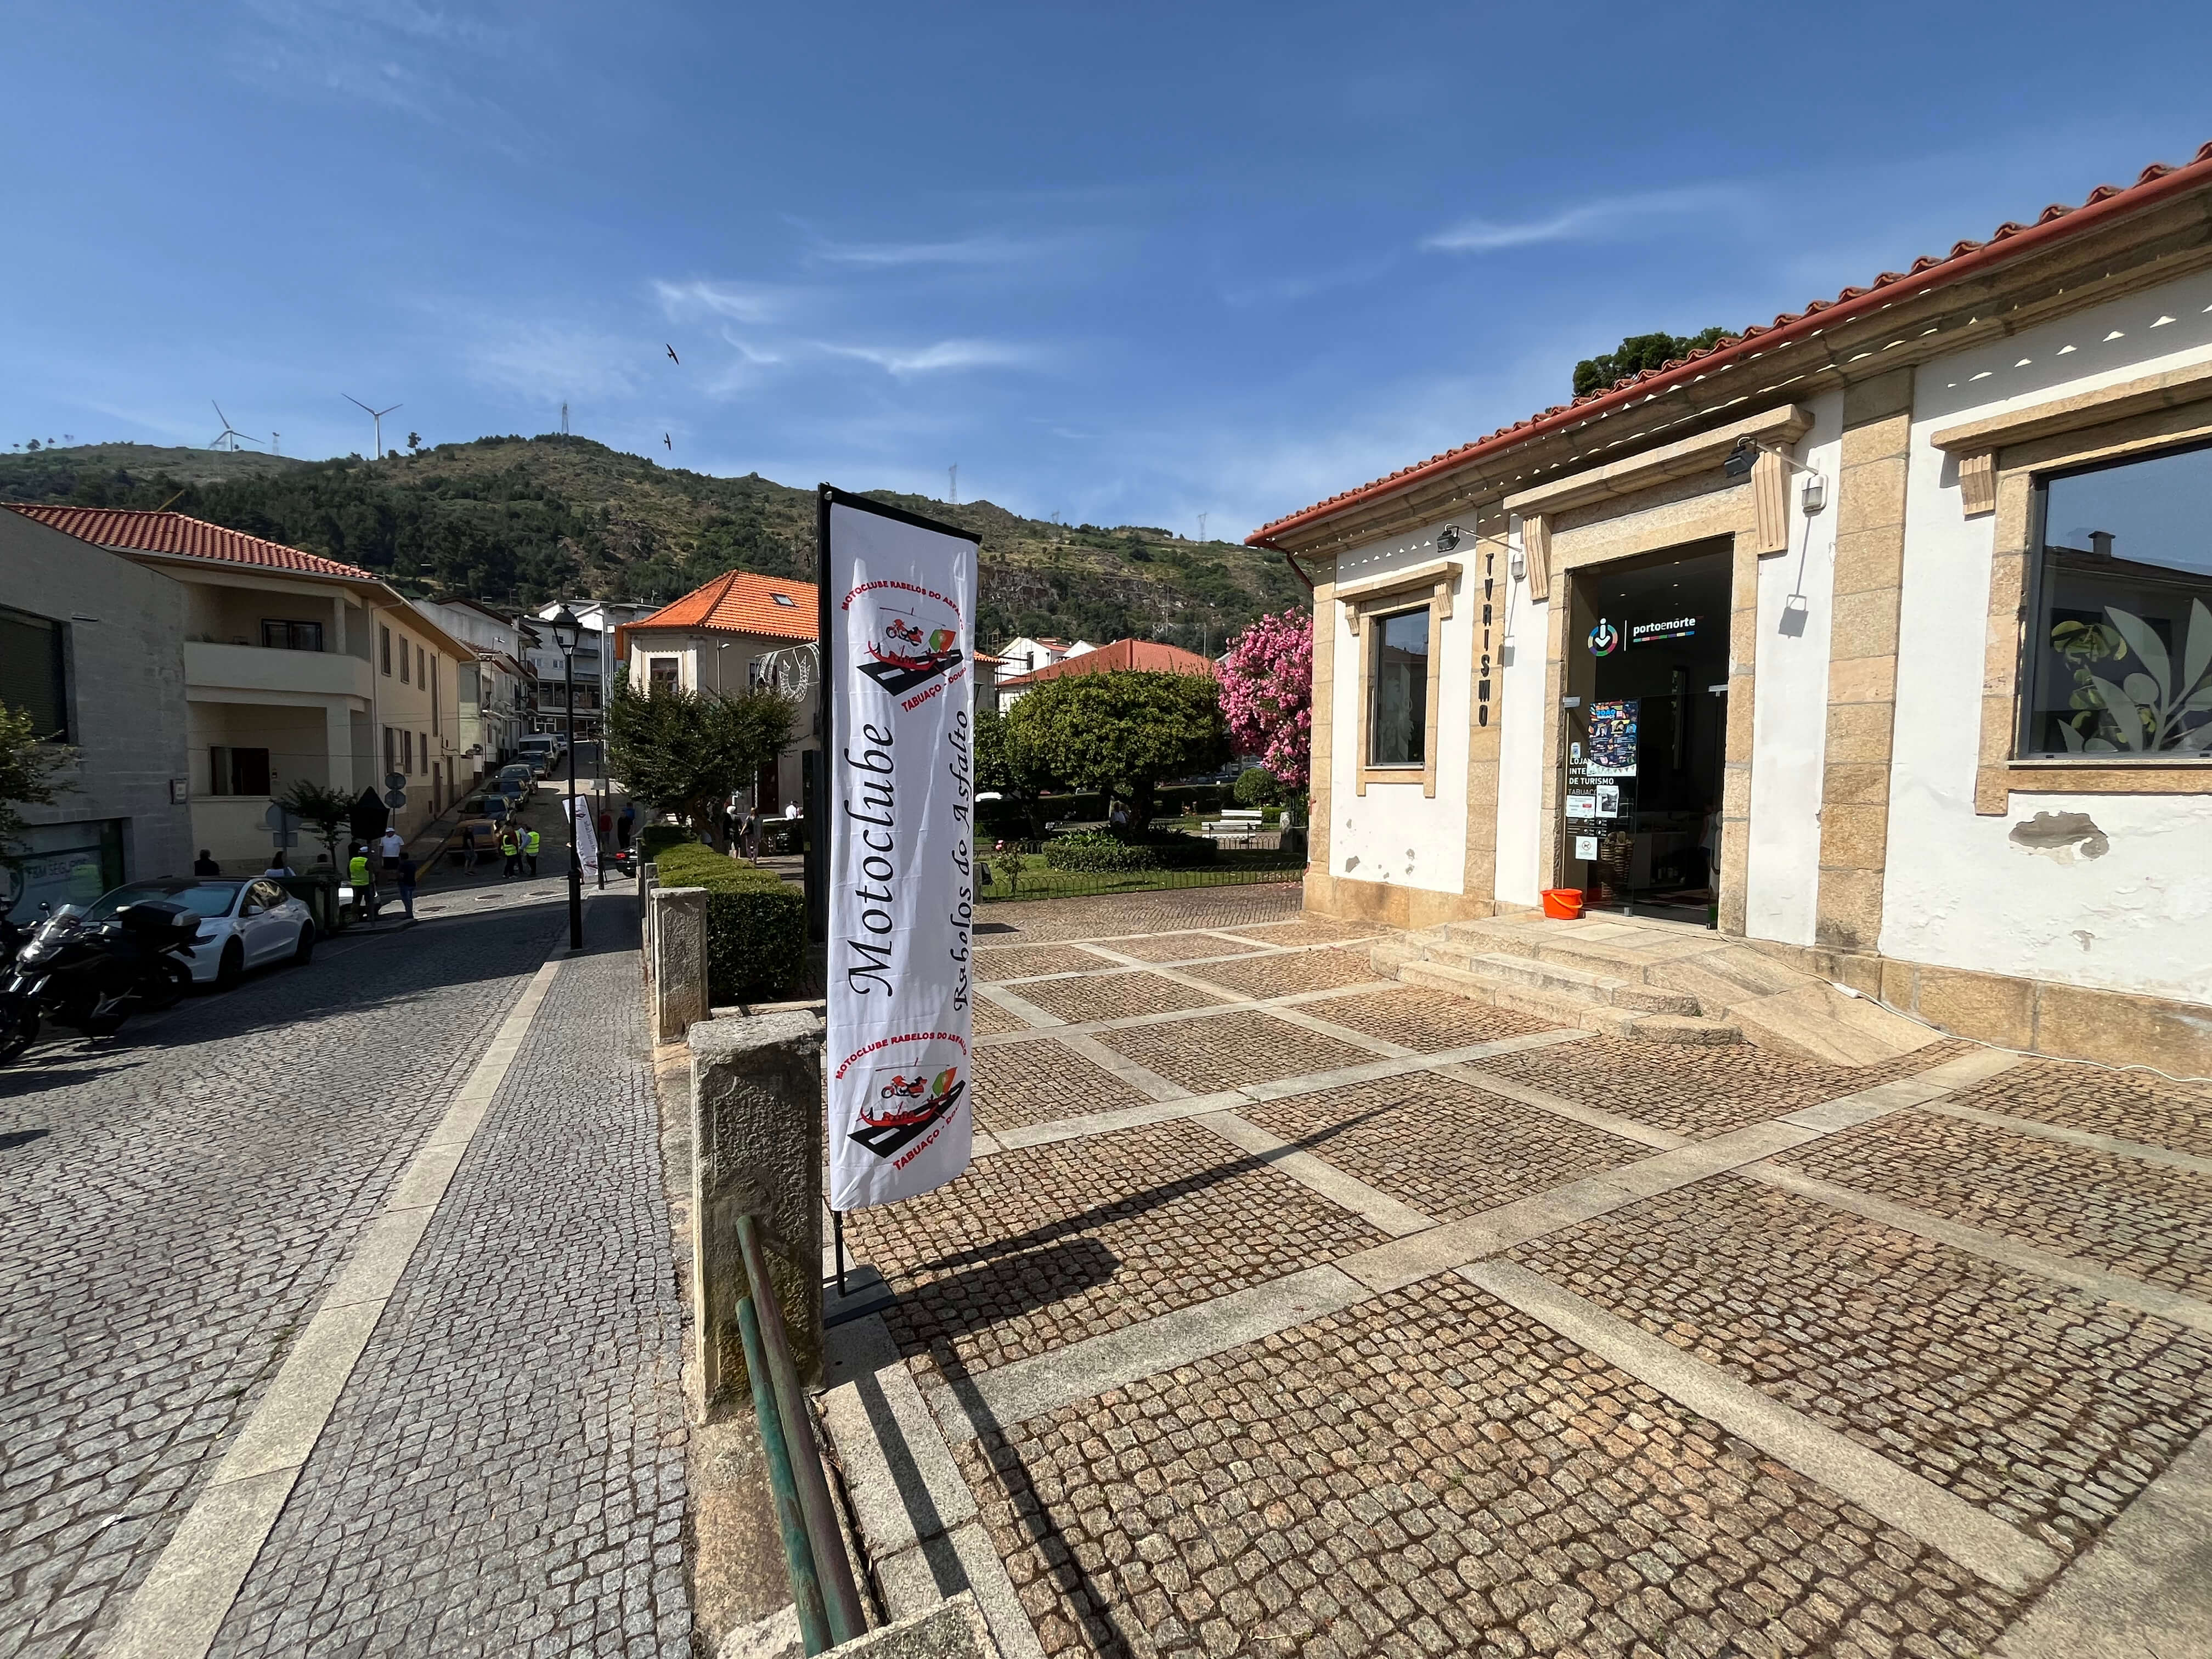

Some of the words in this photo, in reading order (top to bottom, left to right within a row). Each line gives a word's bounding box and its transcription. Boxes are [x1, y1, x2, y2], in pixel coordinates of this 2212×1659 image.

[841, 580, 889, 611] MOTOCLUBE
[890, 581, 927, 595] RABELOS
[929, 590, 941, 600] DO
[901, 684, 941, 712] TABUAÇO
[949, 710, 972, 834] Asfalto
[844, 724, 895, 997] Motoclube
[951, 845, 970, 877] do
[836, 1039, 888, 1080] MOTOCLUBE
[891, 1032, 935, 1045] RABELOS
[893, 1128, 940, 1170] TABUAÇO
